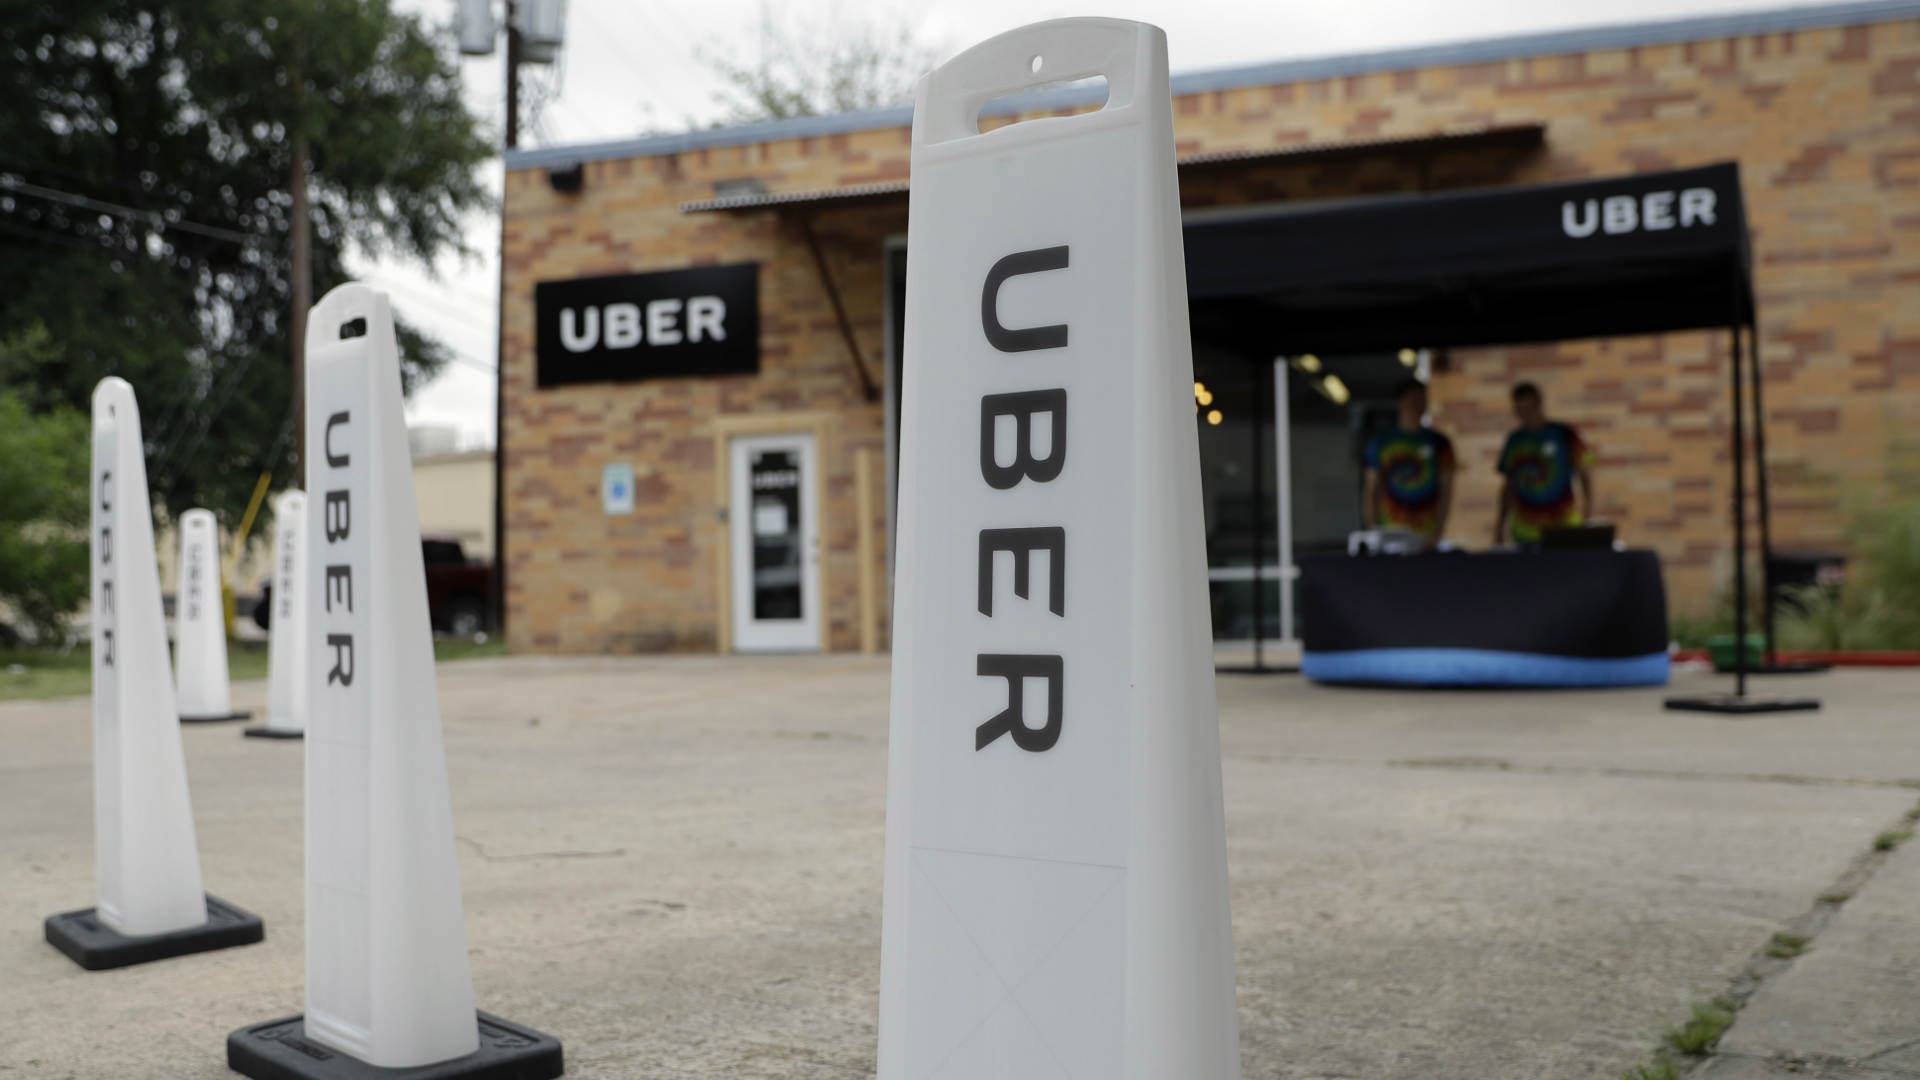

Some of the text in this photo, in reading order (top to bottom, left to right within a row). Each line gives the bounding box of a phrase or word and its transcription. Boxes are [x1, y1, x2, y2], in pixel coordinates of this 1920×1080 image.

[1562, 187, 1717, 238] UBER
[559, 296, 727, 352] UBER
[100, 470, 114, 667] UBER
[326, 410, 354, 687] UBER
[976, 245, 1069, 752] UBER
